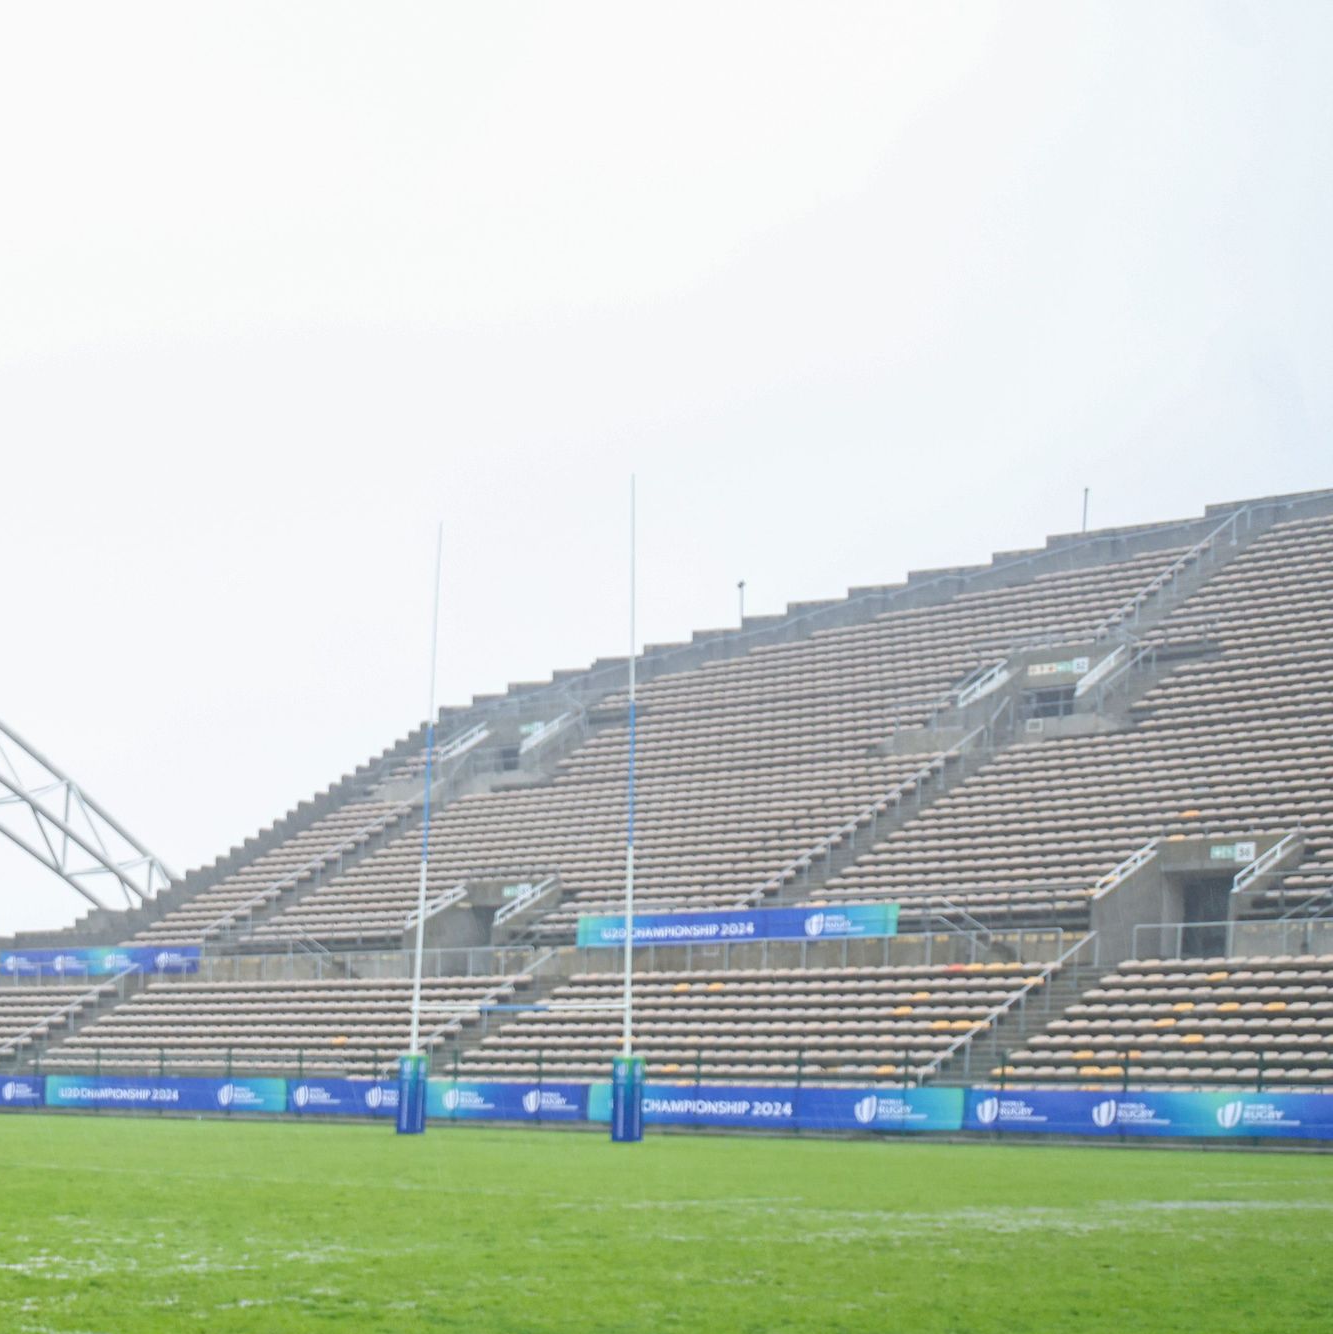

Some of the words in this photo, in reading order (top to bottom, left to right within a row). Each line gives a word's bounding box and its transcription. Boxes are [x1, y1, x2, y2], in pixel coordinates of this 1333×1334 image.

[642, 1098, 750, 1115] CHAMPIONSHIP
[752, 1101, 793, 1117] 2024
[1244, 1109, 1284, 1120] RUGBY
